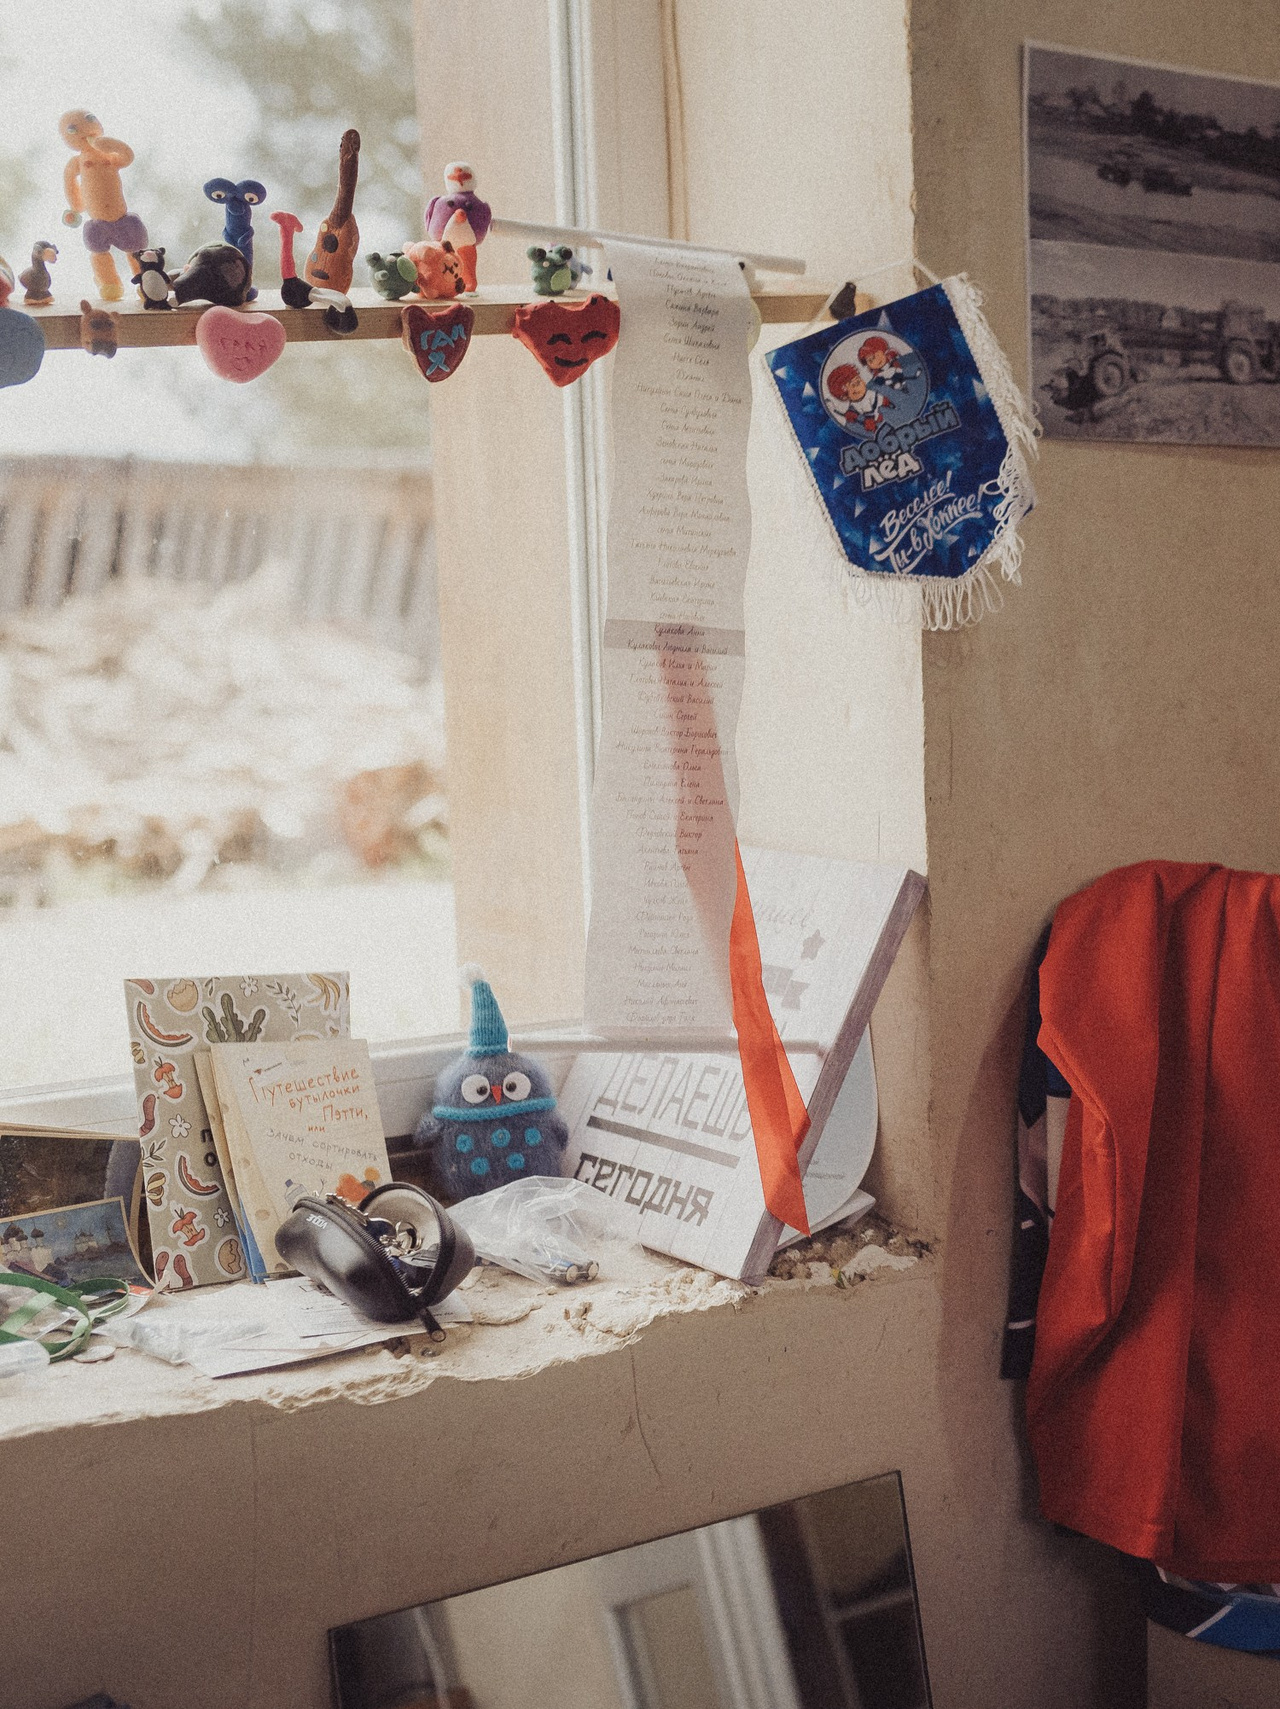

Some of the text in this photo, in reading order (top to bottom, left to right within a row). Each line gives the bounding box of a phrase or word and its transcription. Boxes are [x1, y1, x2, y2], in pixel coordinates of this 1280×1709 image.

[692, 320, 715, 333] Андрей
[654, 621, 706, 637] Кулакова Анна
[627, 638, 661, 651] Кулаковы
[663, 641, 692, 654] Людмила
[701, 644, 728, 655] Василий
[668, 658, 685, 669] Илья
[687, 693, 715, 705] Василий
[676, 709, 699, 722] Сергей
[683, 727, 718, 741] Борисович
[680, 777, 701, 788] Елена
[694, 795, 725, 806] Светлана
[679, 811, 714, 824] Екатерина
[678, 828, 703, 841] Виктор
[249, 1066, 360, 1107] Путешествие
[592, 1051, 752, 1143] ДЕЛАЕШЬ
[322, 1104, 369, 1122] Пэтти,
[308, 1126, 326, 1134] или
